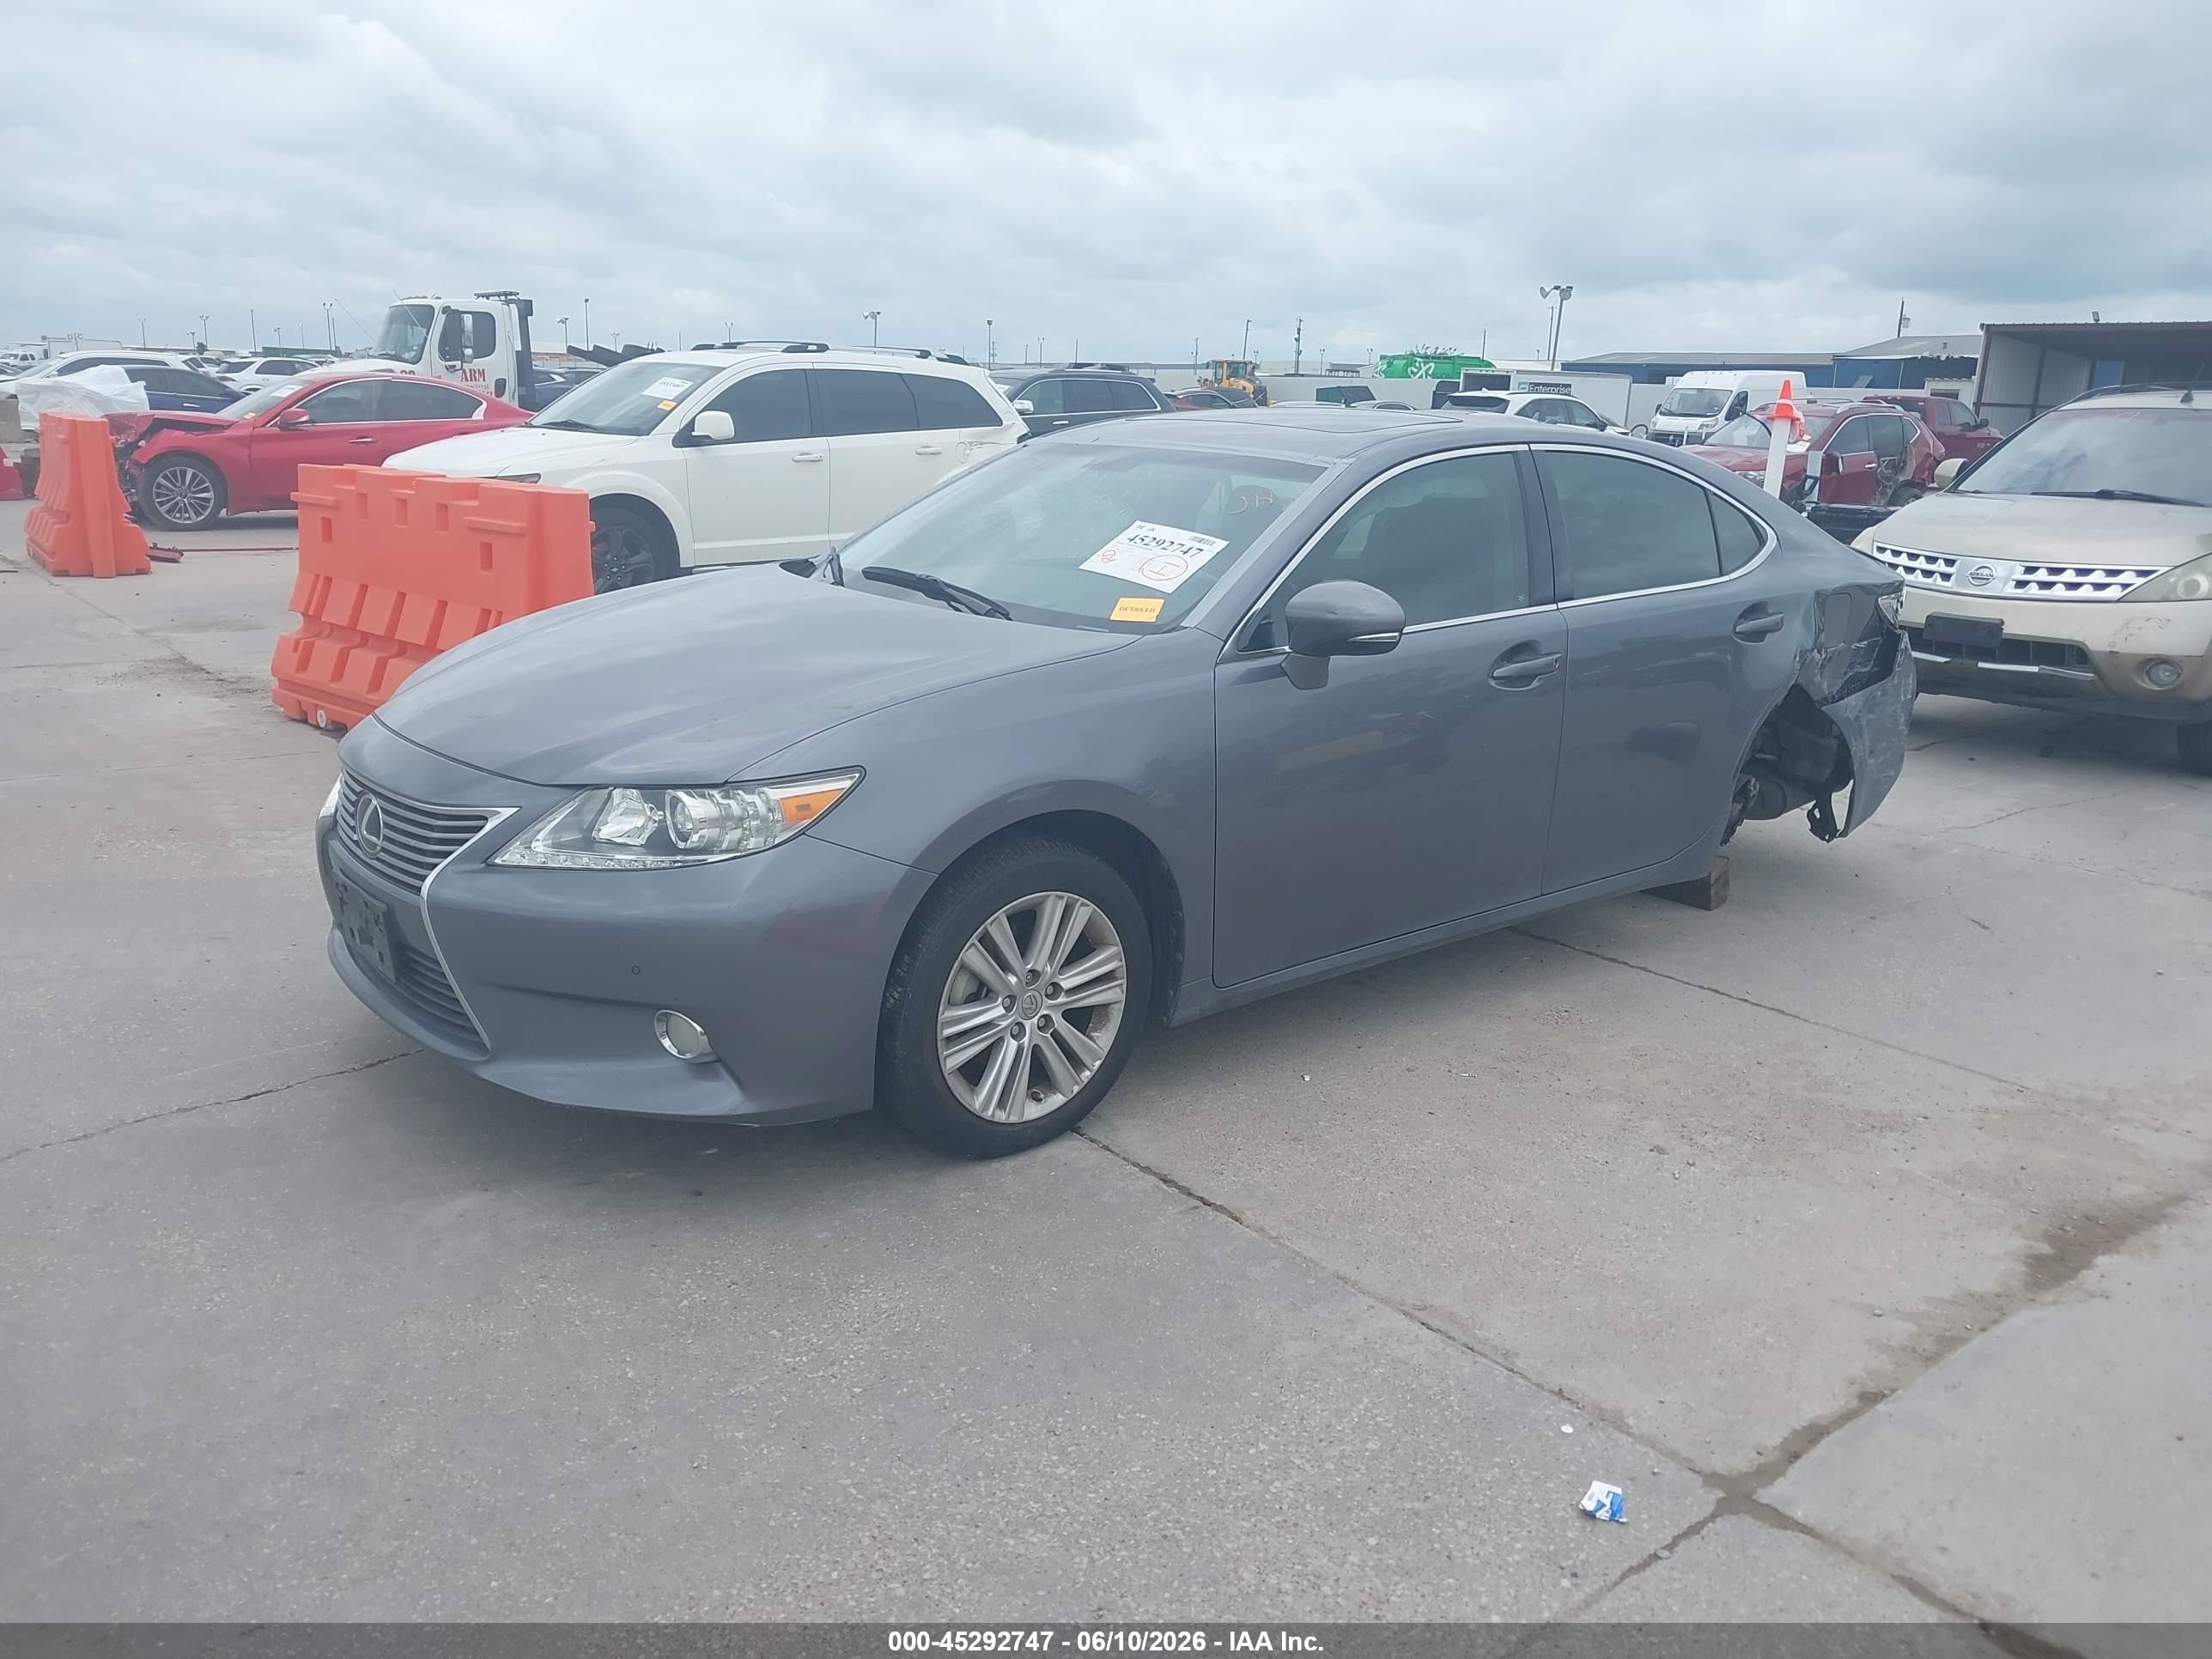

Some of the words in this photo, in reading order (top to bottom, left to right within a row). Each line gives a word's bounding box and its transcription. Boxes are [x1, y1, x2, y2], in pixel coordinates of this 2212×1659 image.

[460, 368, 486, 382] ARM
[1529, 384, 1571, 395] Enterprise
[1127, 534, 1204, 558] 45292747
